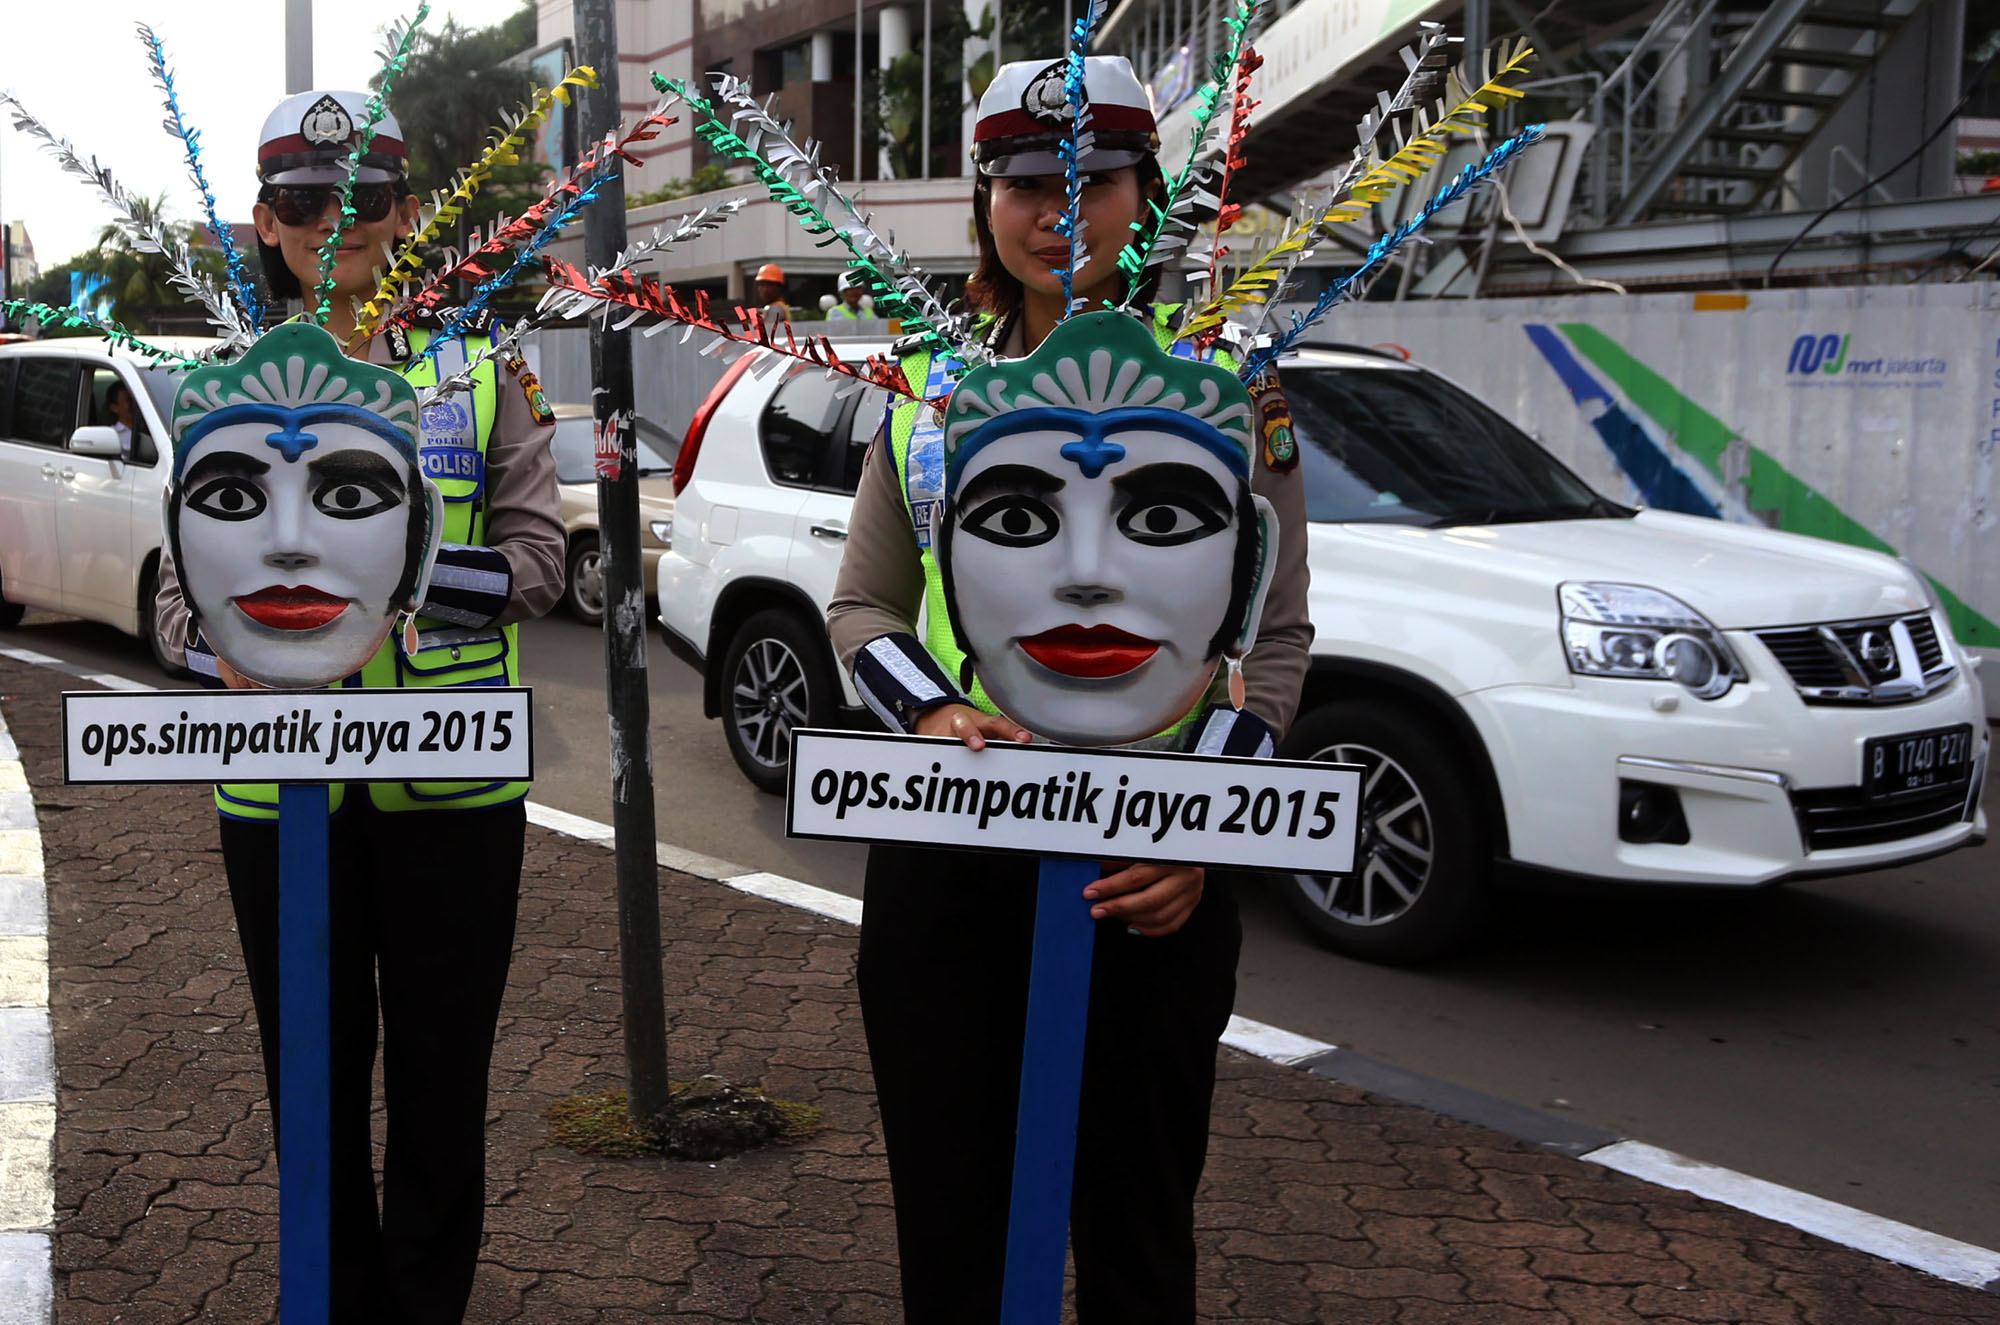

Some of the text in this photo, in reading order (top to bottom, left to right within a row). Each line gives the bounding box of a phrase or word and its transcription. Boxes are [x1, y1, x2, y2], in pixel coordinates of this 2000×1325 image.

[1846, 358, 1883, 375] mrt
[1884, 357, 1947, 378] jakarta
[427, 437, 465, 446] POLRI
[420, 454, 477, 476] POLISI
[81, 709, 514, 767] ops.simpatik jaya 2015
[1873, 745, 1885, 779] B
[1898, 737, 1936, 775] 1740
[810, 761, 1341, 844] ops.simpatik jaya 2015
